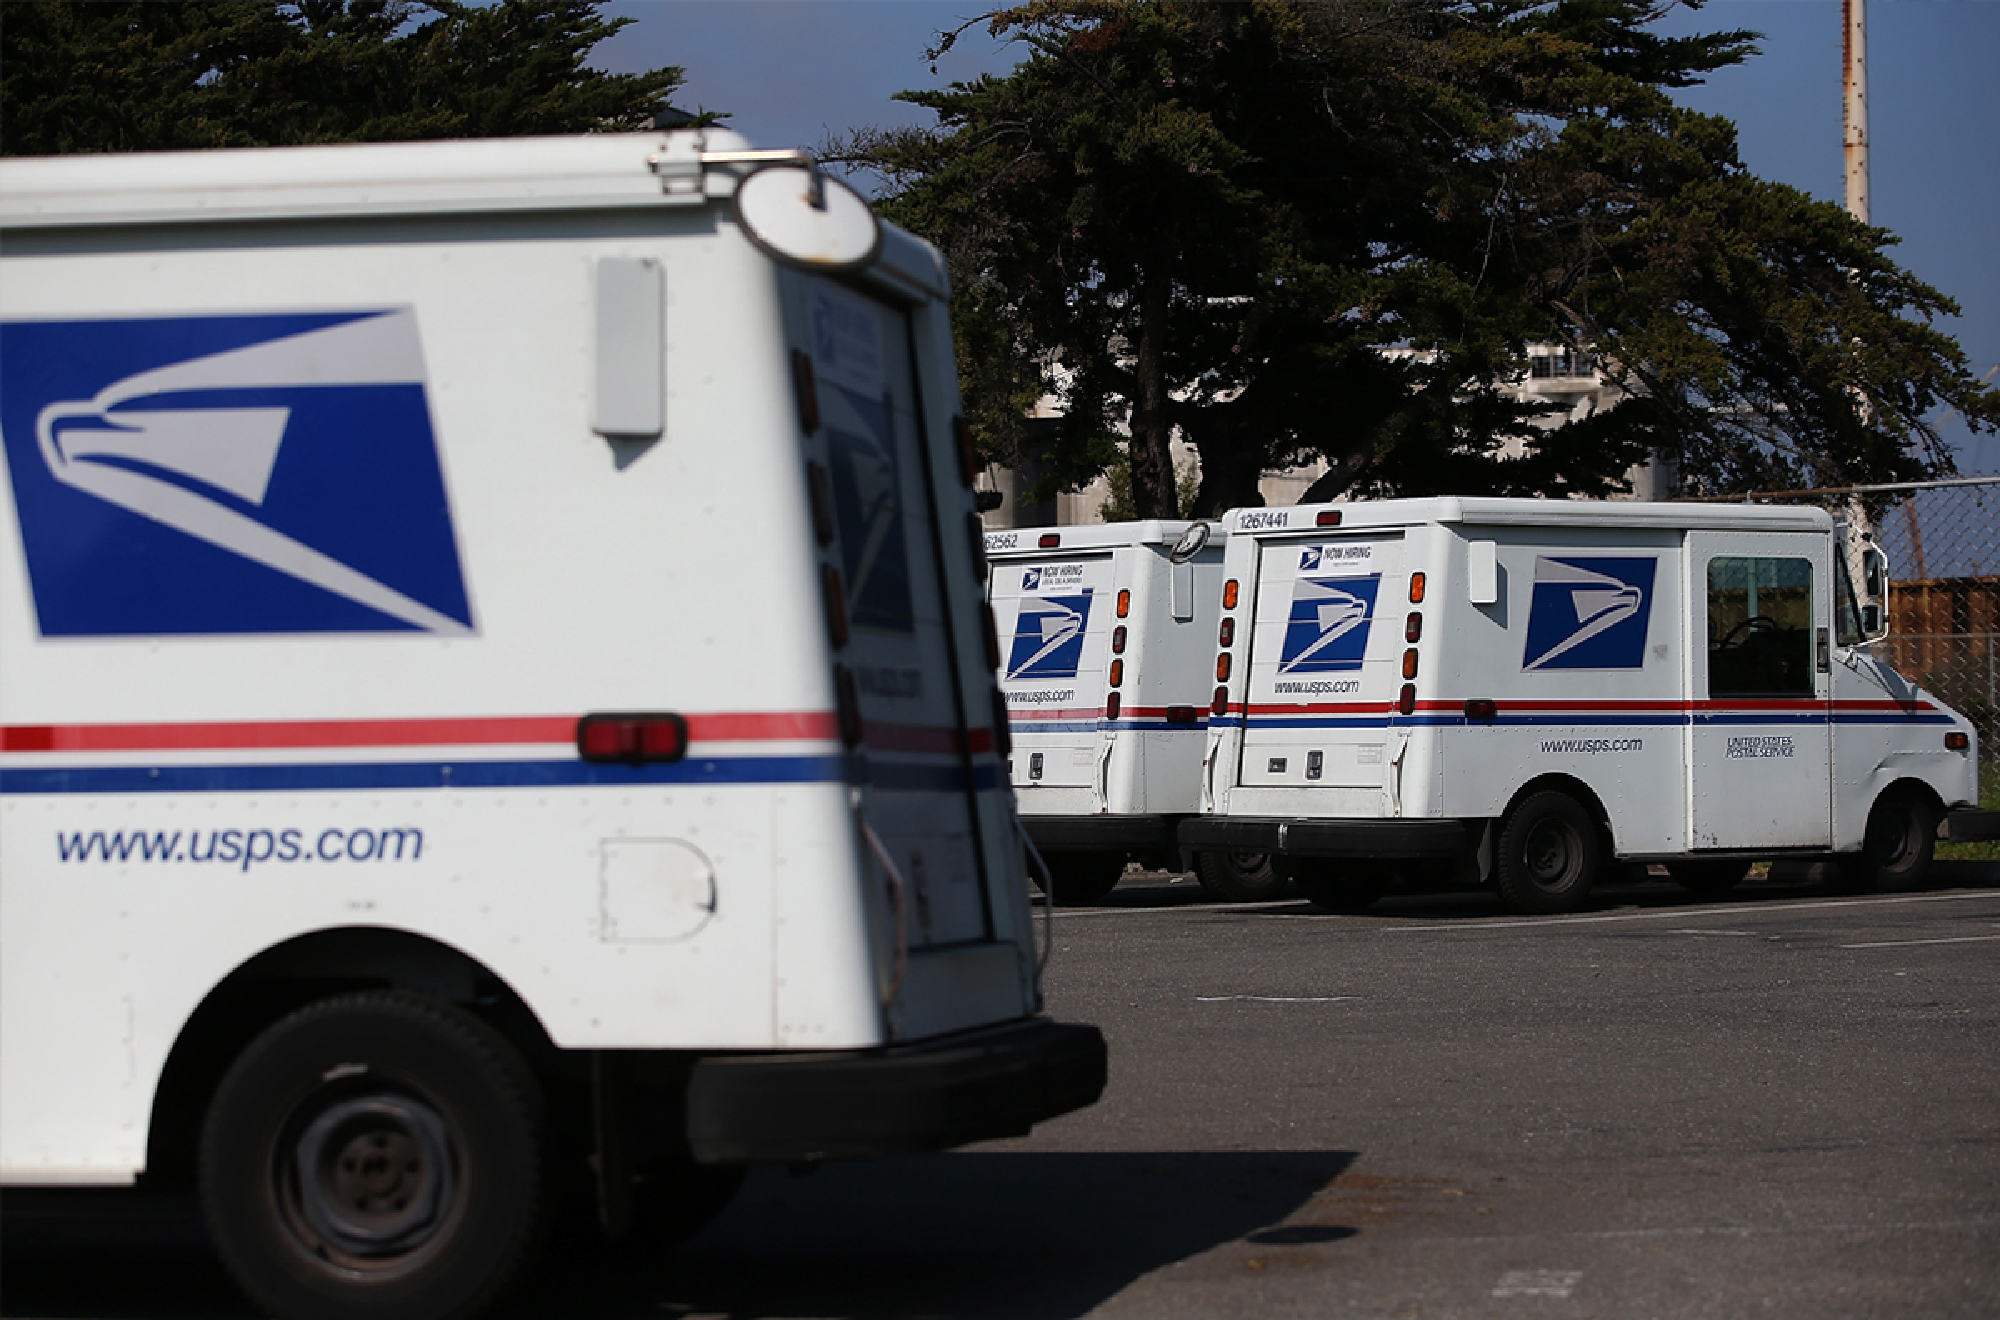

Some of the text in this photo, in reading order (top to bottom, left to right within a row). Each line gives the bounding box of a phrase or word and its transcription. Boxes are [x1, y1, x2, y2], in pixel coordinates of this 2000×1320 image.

[1240, 512, 1288, 528] 1267441
[1275, 680, 1359, 698] www.usps.com
[1541, 739, 1643, 756] www.usps.com
[1727, 736, 1793, 748] UNITED STATES
[1725, 747, 1794, 758] POSTAL SERVICE
[56, 826, 424, 873] www.usps.com
